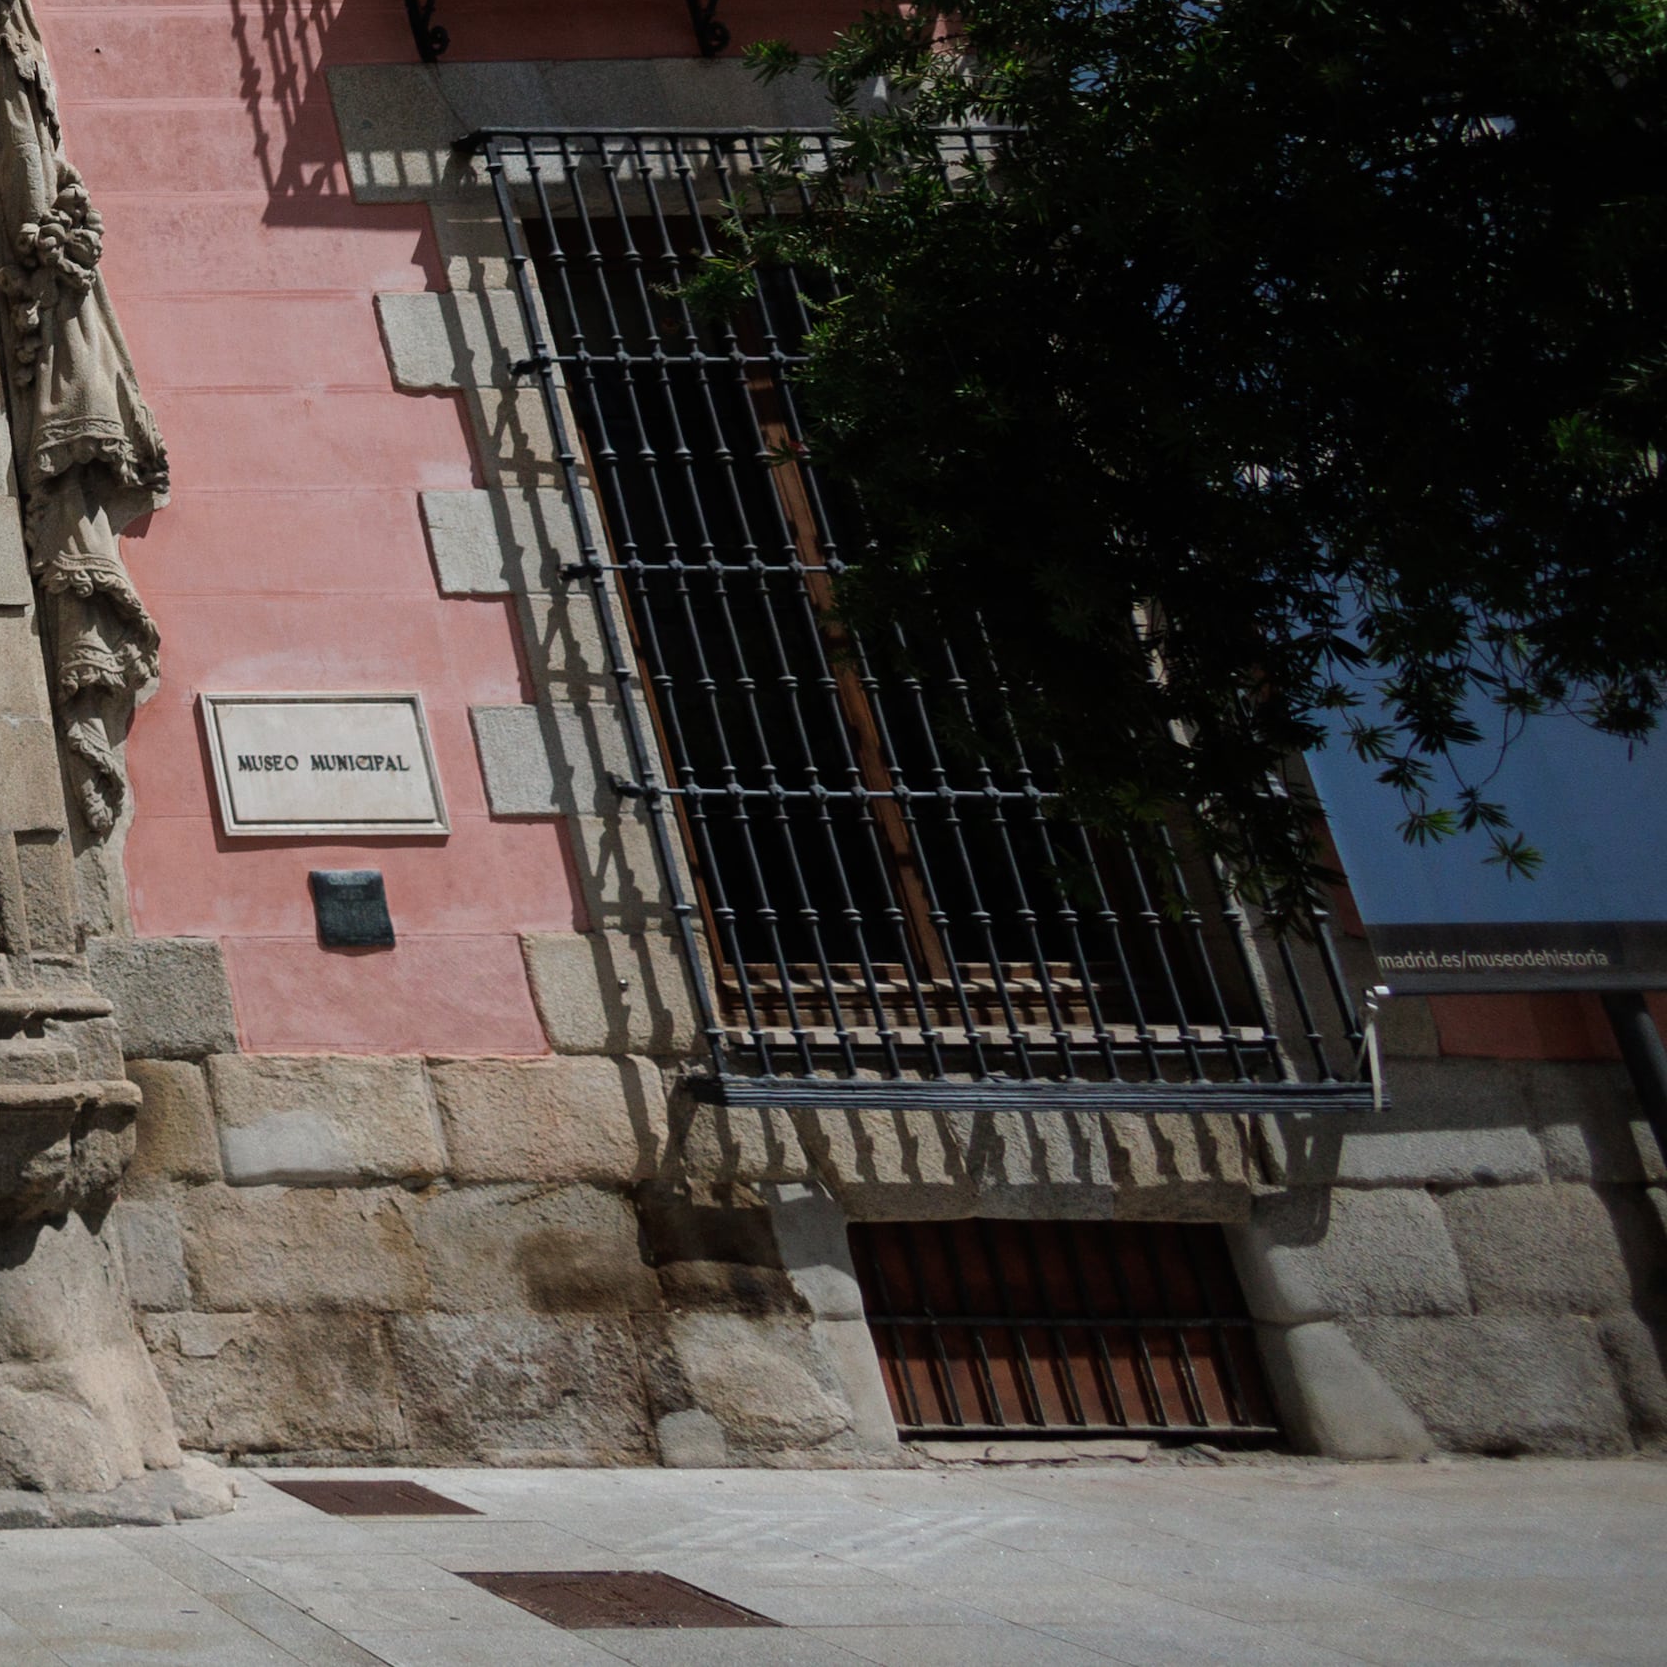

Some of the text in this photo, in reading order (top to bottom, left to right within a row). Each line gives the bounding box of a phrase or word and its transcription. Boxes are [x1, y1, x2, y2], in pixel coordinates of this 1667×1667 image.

[238, 755, 410, 771] MUSEO MUNICIPAL
[1378, 949, 1609, 969] madrid.es/museodehistoria
